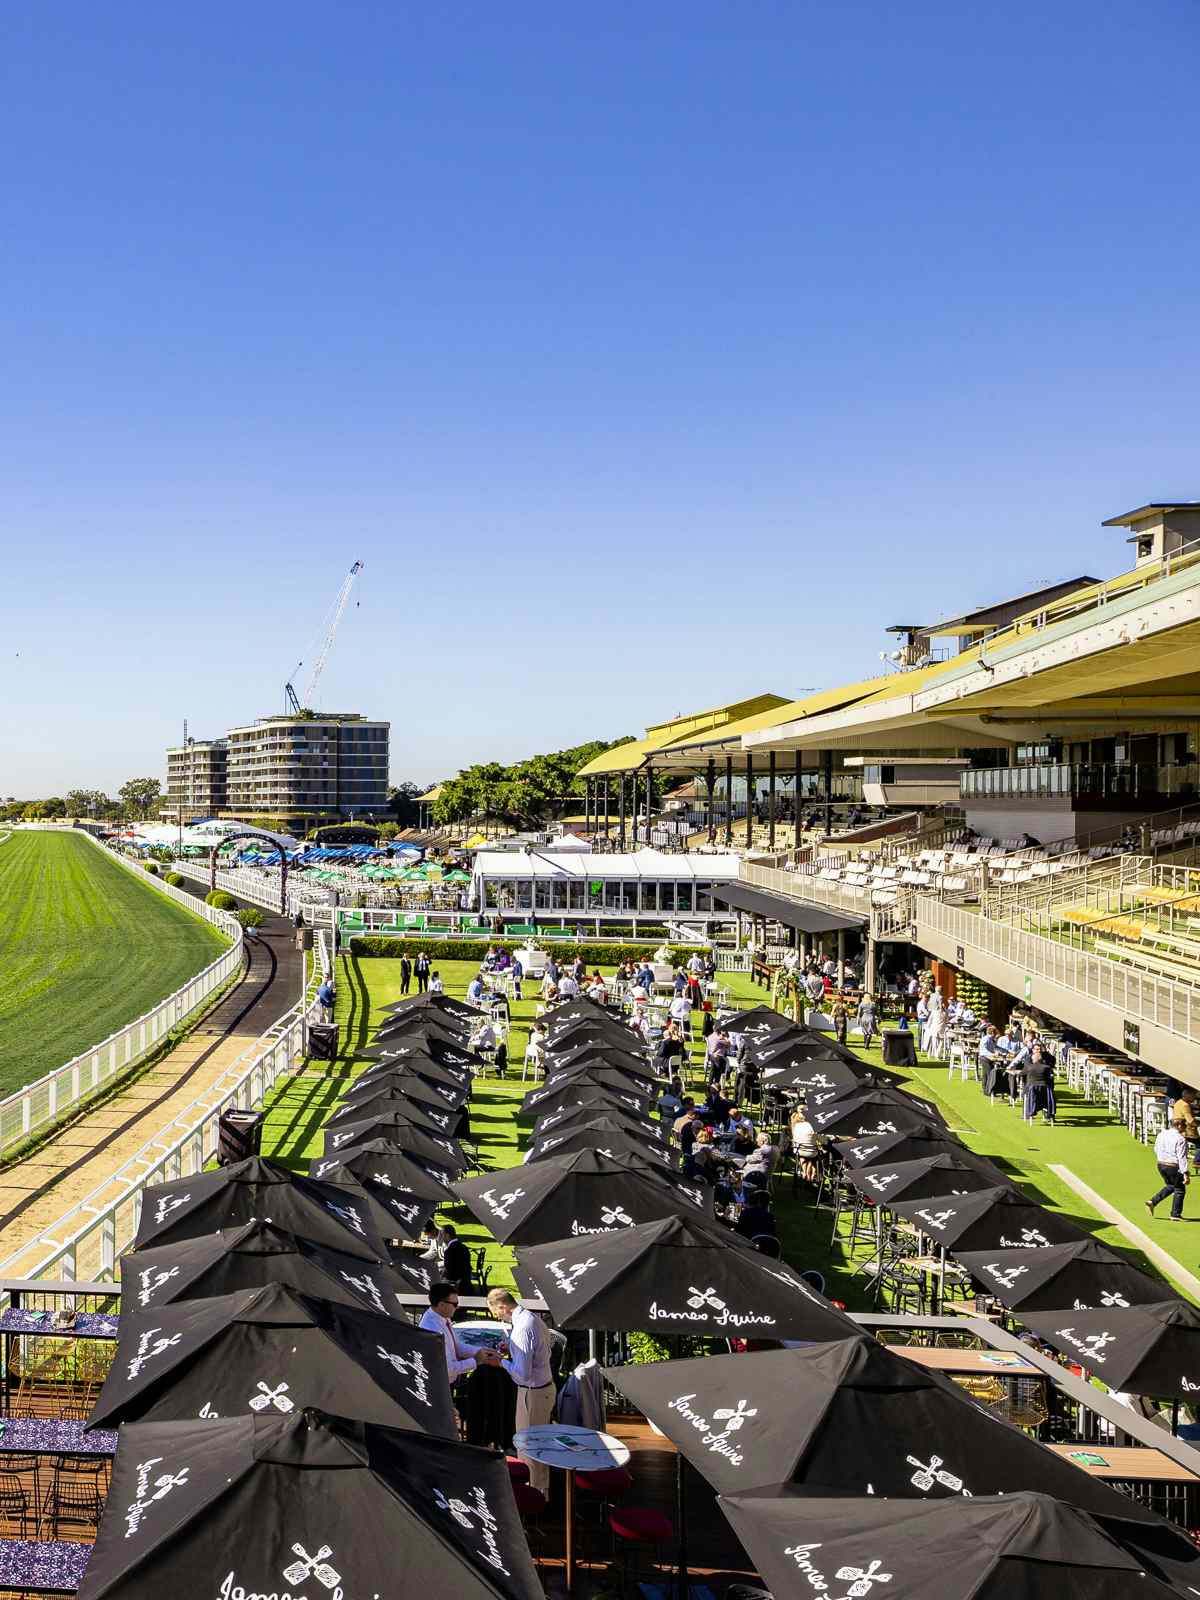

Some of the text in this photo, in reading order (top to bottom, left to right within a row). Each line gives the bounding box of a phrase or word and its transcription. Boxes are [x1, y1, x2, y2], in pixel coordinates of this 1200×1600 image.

[1000, 1236, 1037, 1248] James
[649, 1301, 776, 1327] James Squire
[668, 1393, 744, 1466] James Squire
[125, 1456, 164, 1538] James Squire
[784, 1543, 829, 1590] James
